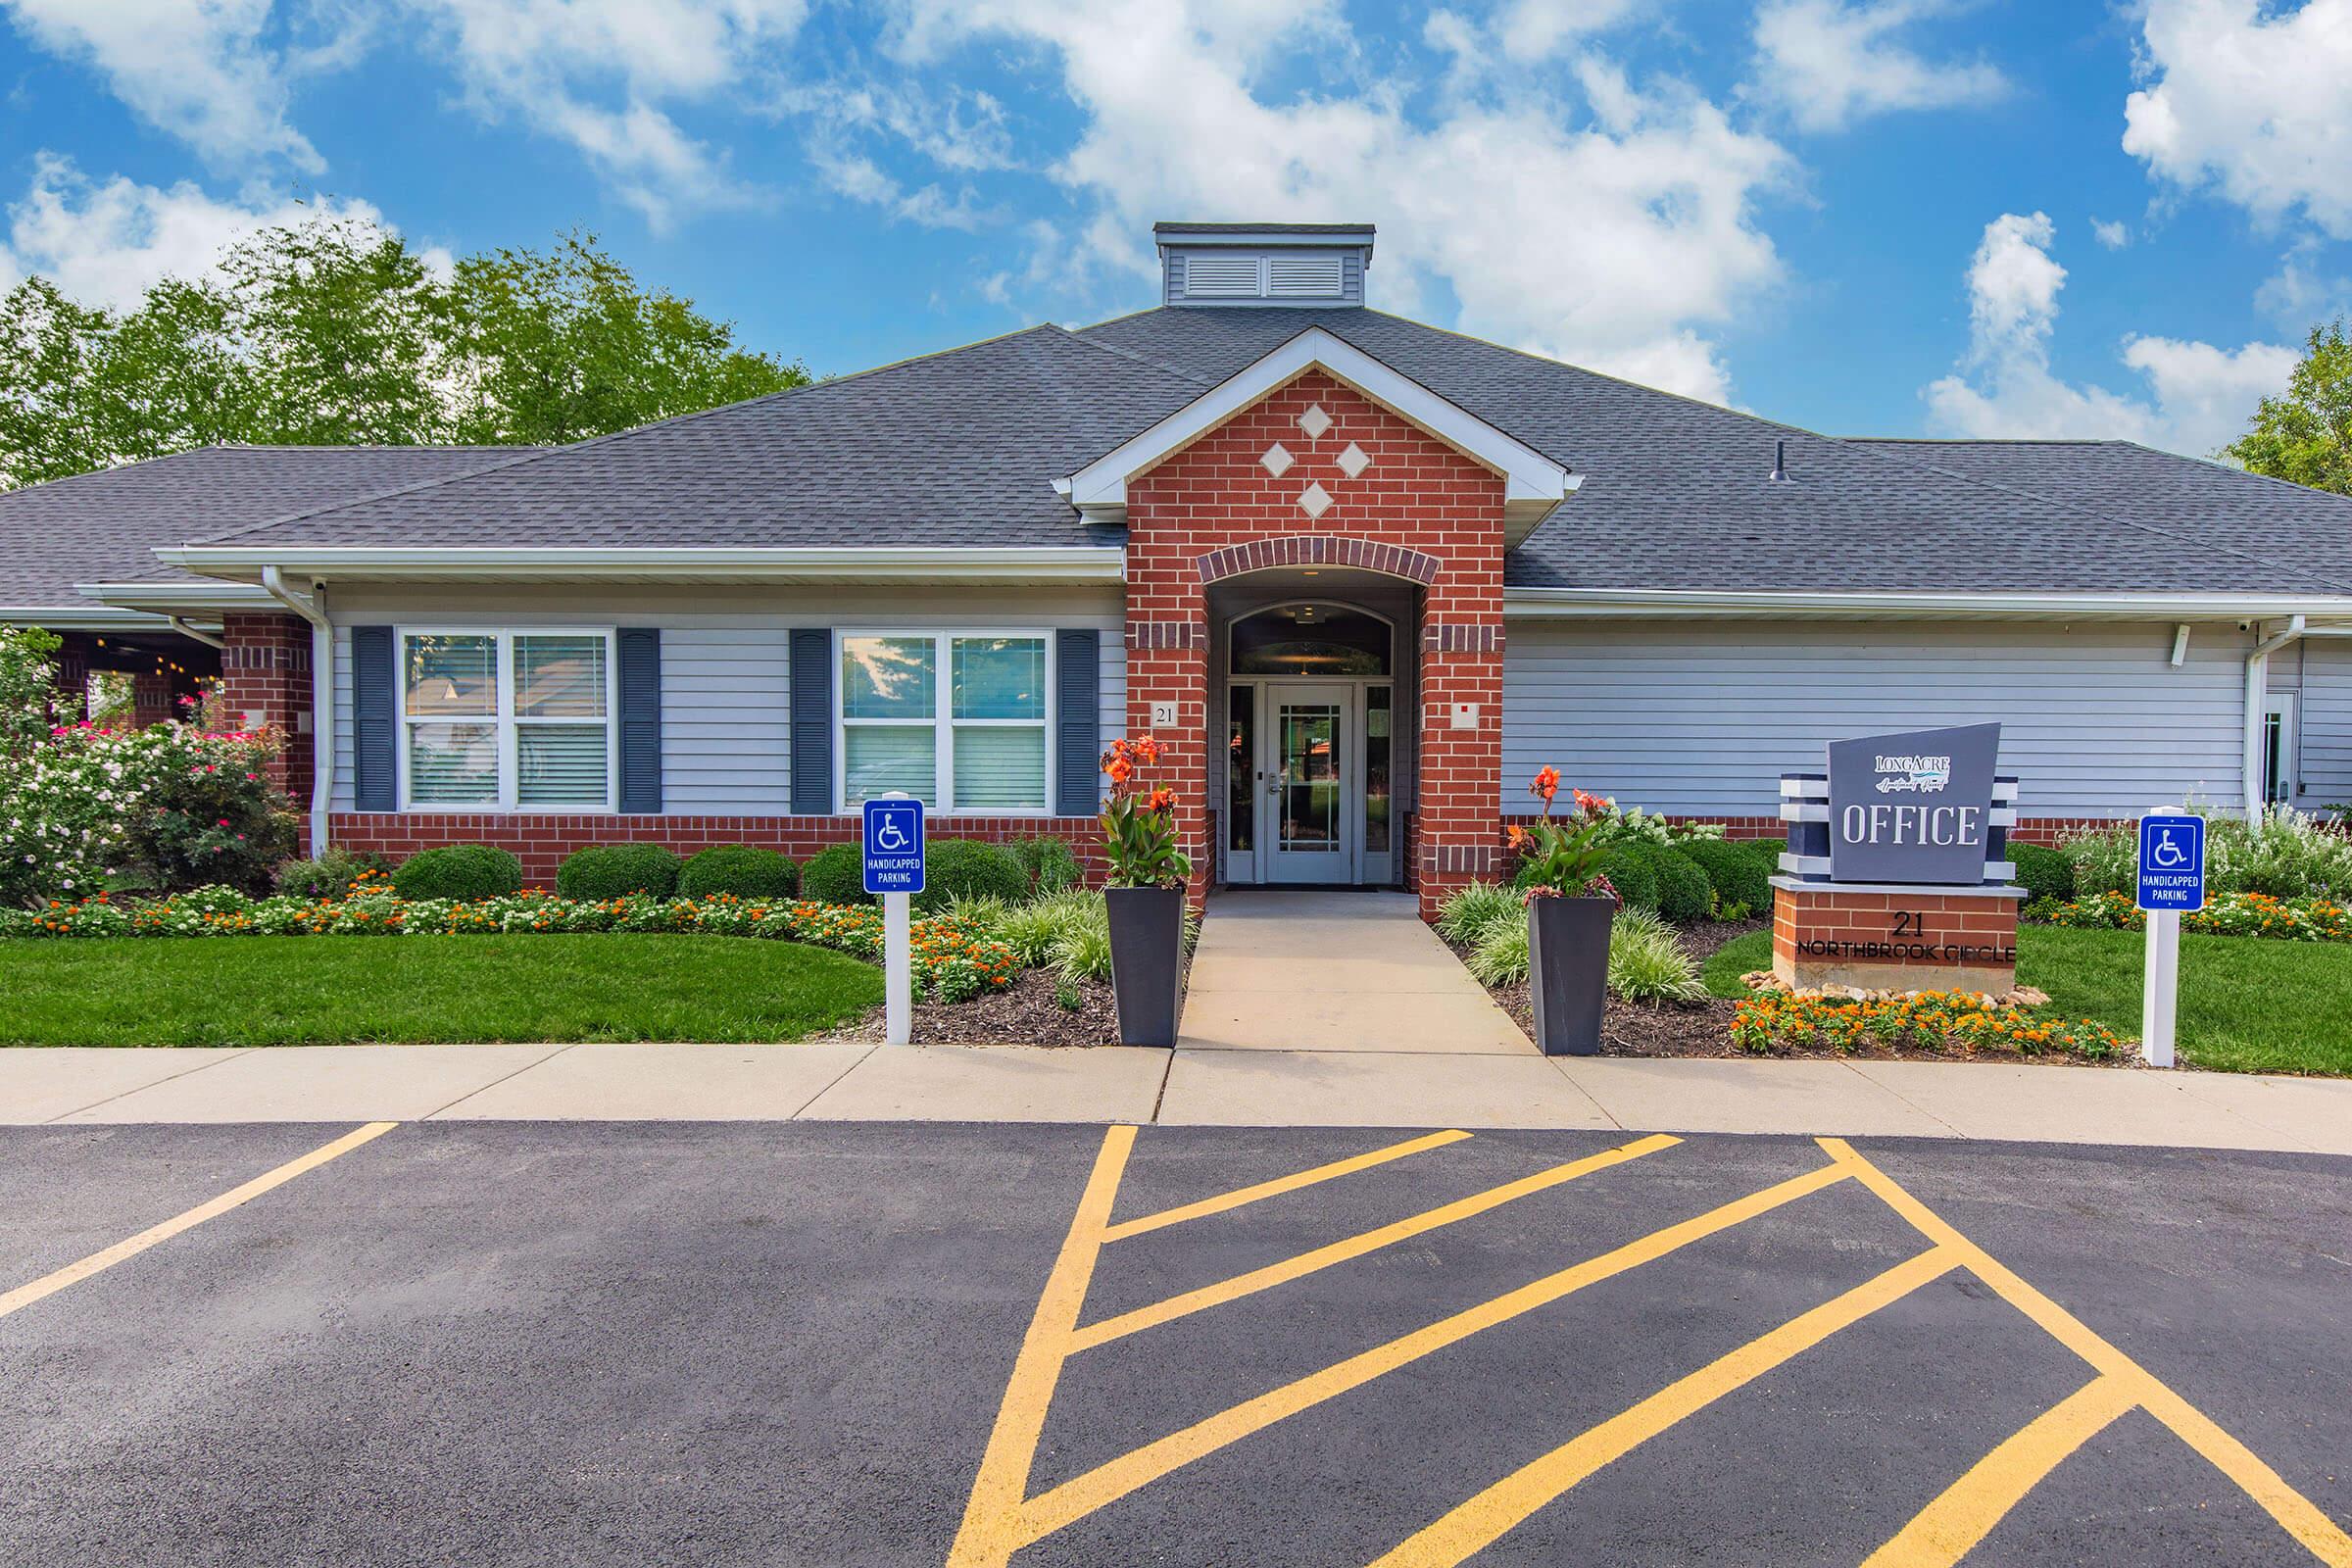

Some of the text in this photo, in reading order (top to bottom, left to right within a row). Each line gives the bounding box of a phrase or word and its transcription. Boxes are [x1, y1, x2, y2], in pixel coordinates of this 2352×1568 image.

[1156, 708, 1171, 722] 21
[1843, 805, 1980, 845] OFFICE
[867, 858, 920, 869] HANDICAPPED
[878, 872, 910, 883] PARKING
[2142, 875, 2198, 887] HANDICAPPED
[2152, 889, 2187, 901] PARKING
[1891, 911, 1924, 937] 21
[1796, 940, 2017, 962] NORTHBROOK CIRCLE
